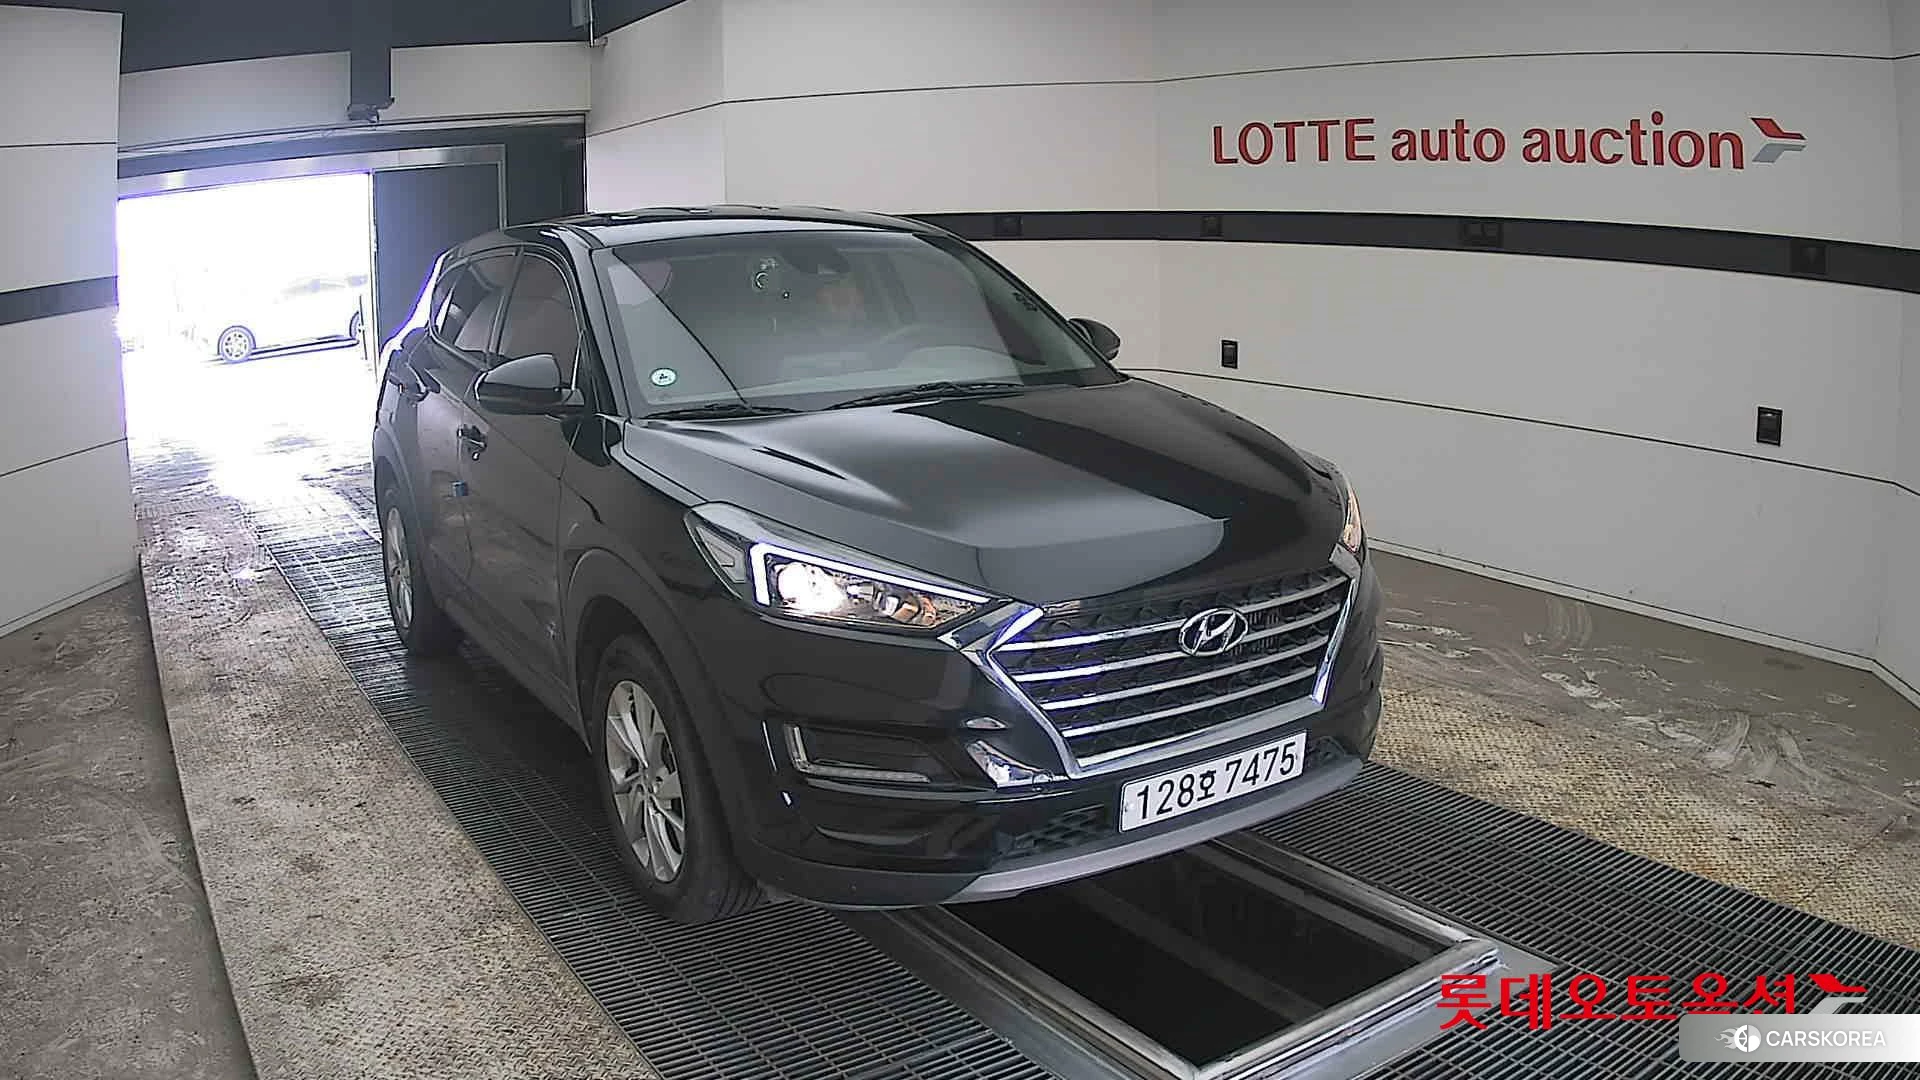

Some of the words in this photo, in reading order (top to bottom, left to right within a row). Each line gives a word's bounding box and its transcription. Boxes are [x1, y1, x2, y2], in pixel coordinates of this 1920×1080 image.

[1212, 118, 1376, 165] LOTTE
[1391, 119, 1506, 163] auto
[1522, 111, 1745, 170] auction
[1136, 769, 1217, 820] 128호
[1225, 741, 1297, 794] 7475
